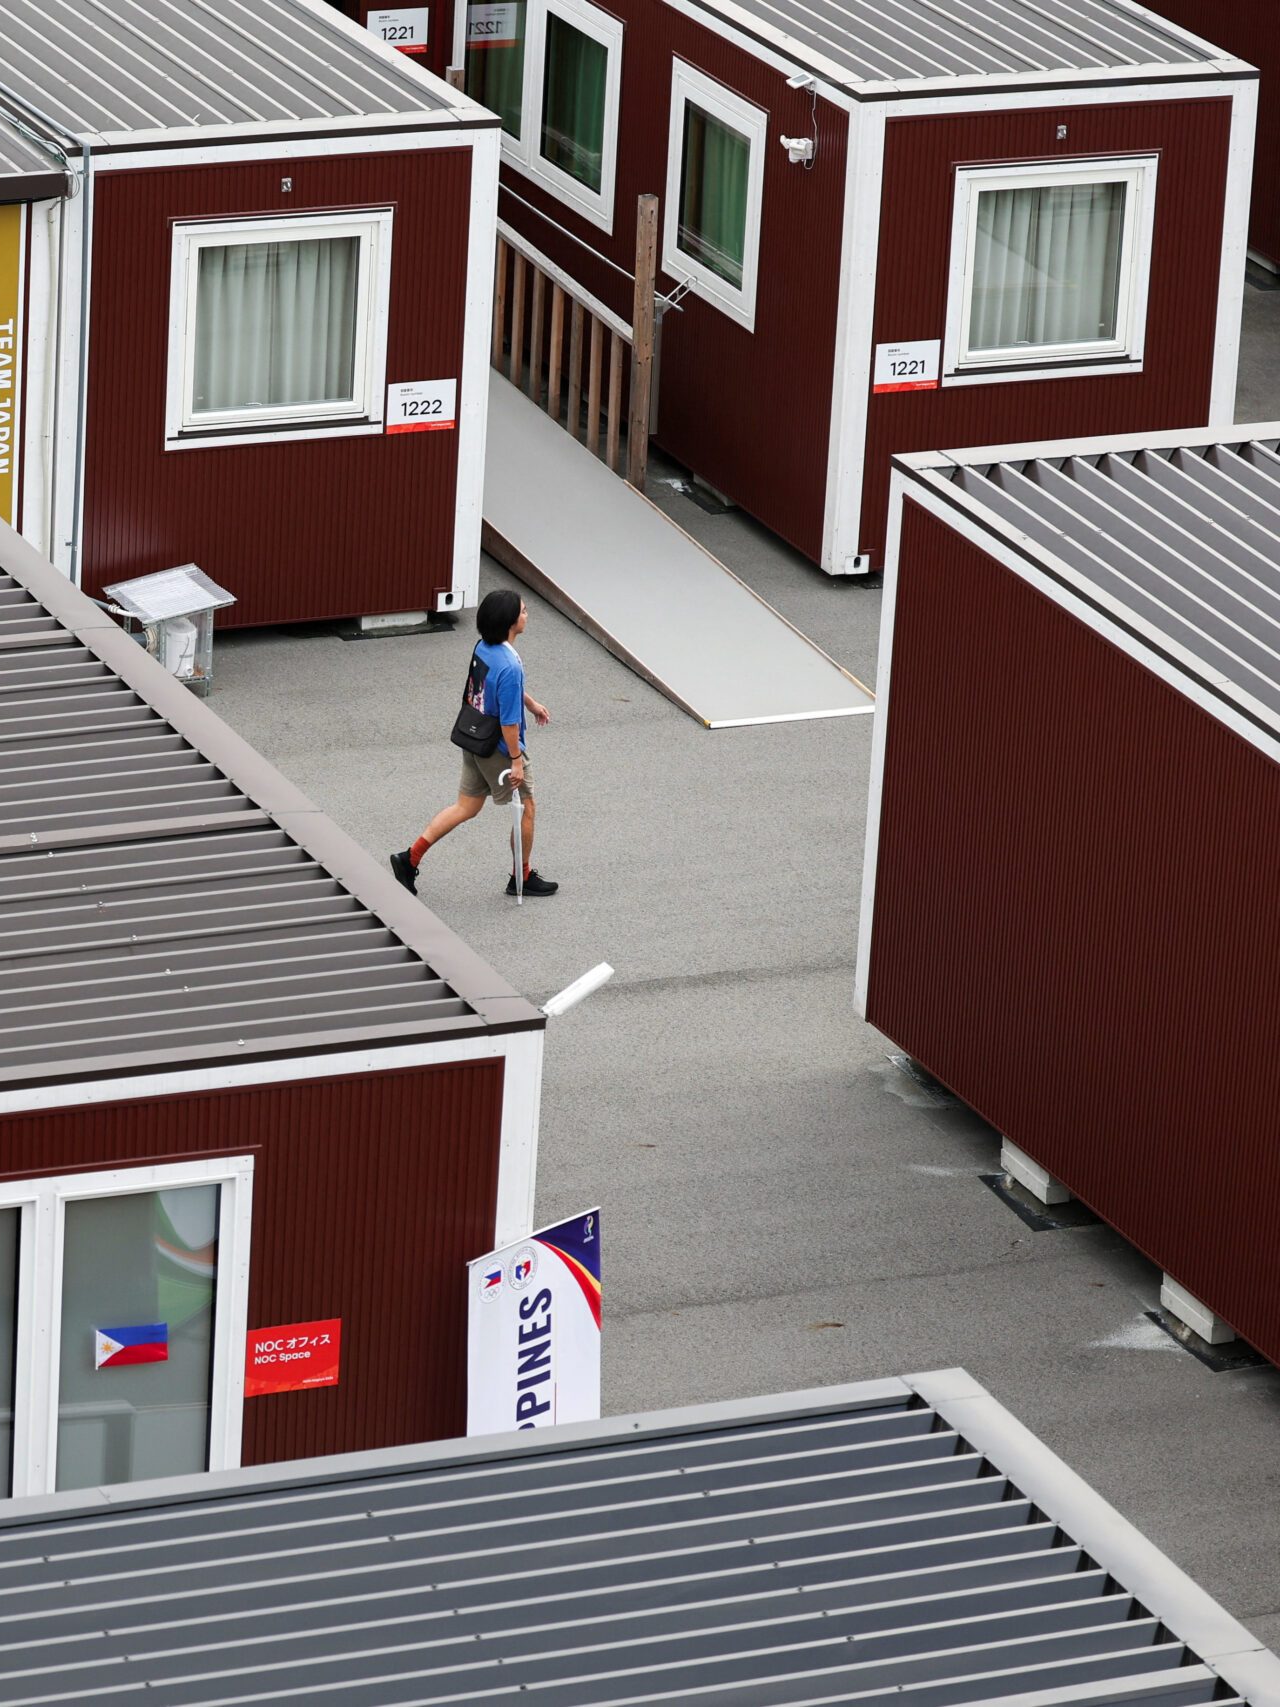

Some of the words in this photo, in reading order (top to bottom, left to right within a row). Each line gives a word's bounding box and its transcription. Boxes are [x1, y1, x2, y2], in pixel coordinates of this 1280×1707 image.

[381, 26, 414, 40] 1221
[890, 360, 925, 376] 1221
[401, 399, 442, 416] 1222
[255, 1339, 284, 1354] NOC
[286, 1334, 331, 1349] オフィス
[254, 1354, 277, 1365] NOC
[279, 1351, 311, 1363] Space
[516, 1288, 552, 1430] PINES
